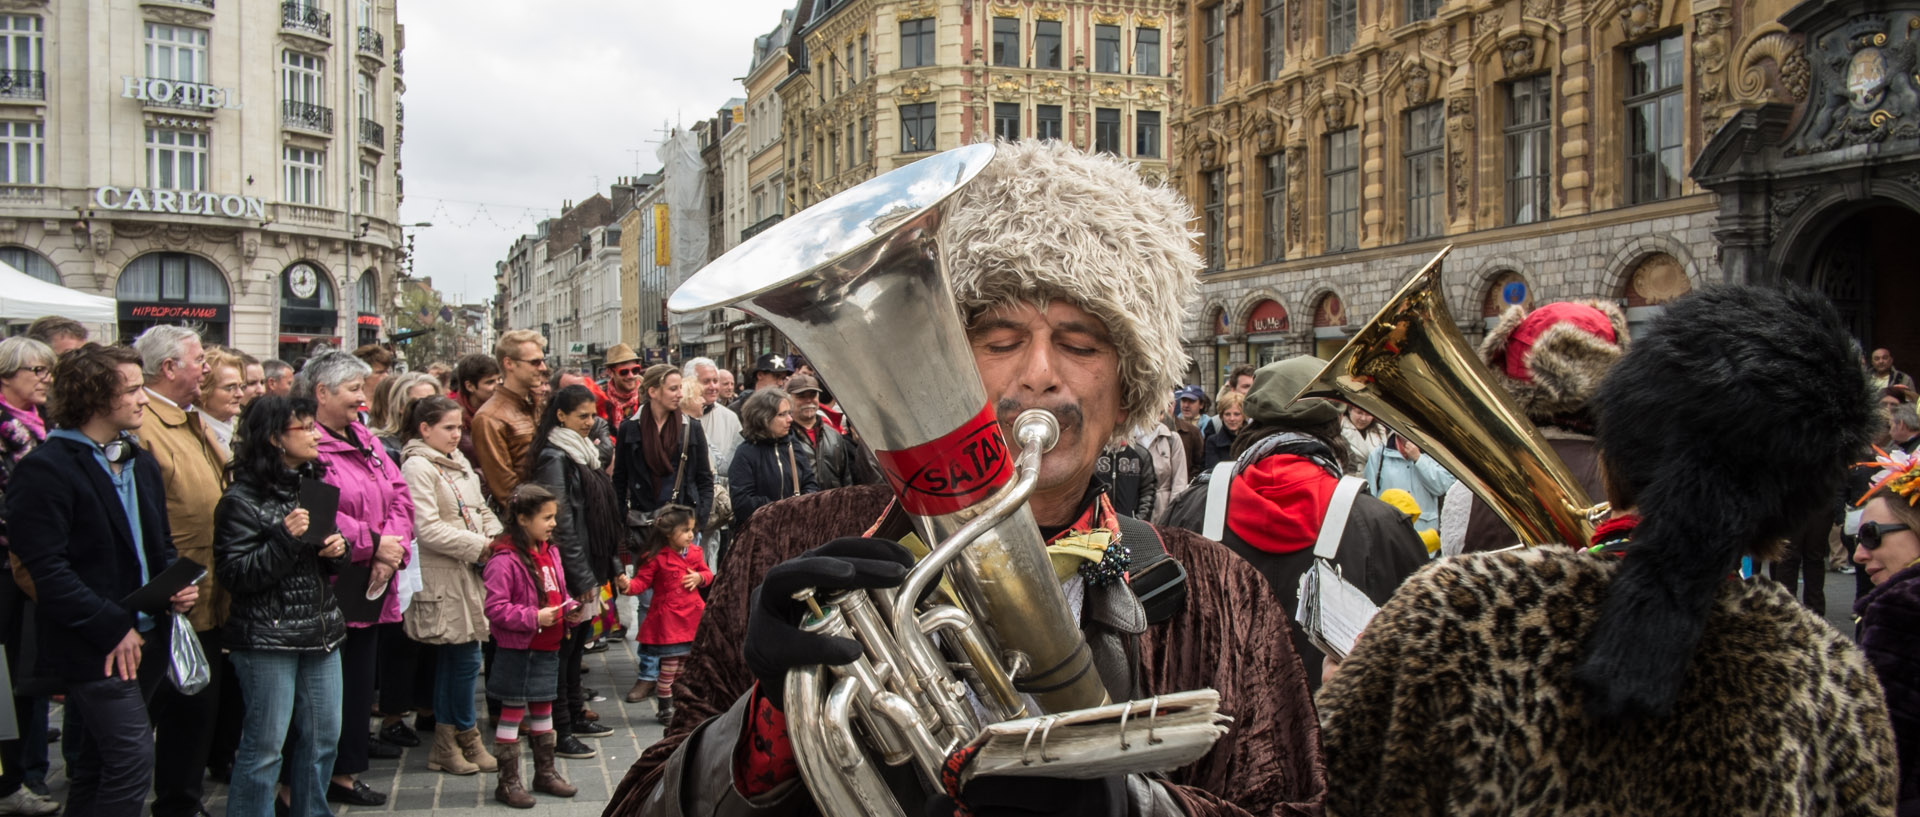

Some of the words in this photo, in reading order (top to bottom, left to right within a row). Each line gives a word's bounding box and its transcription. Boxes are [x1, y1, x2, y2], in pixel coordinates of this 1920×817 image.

[121, 75, 243, 110] HOTEL
[96, 185, 267, 218] CARLTON
[924, 425, 1006, 492] SATAN
[1119, 457, 1140, 473] 84
